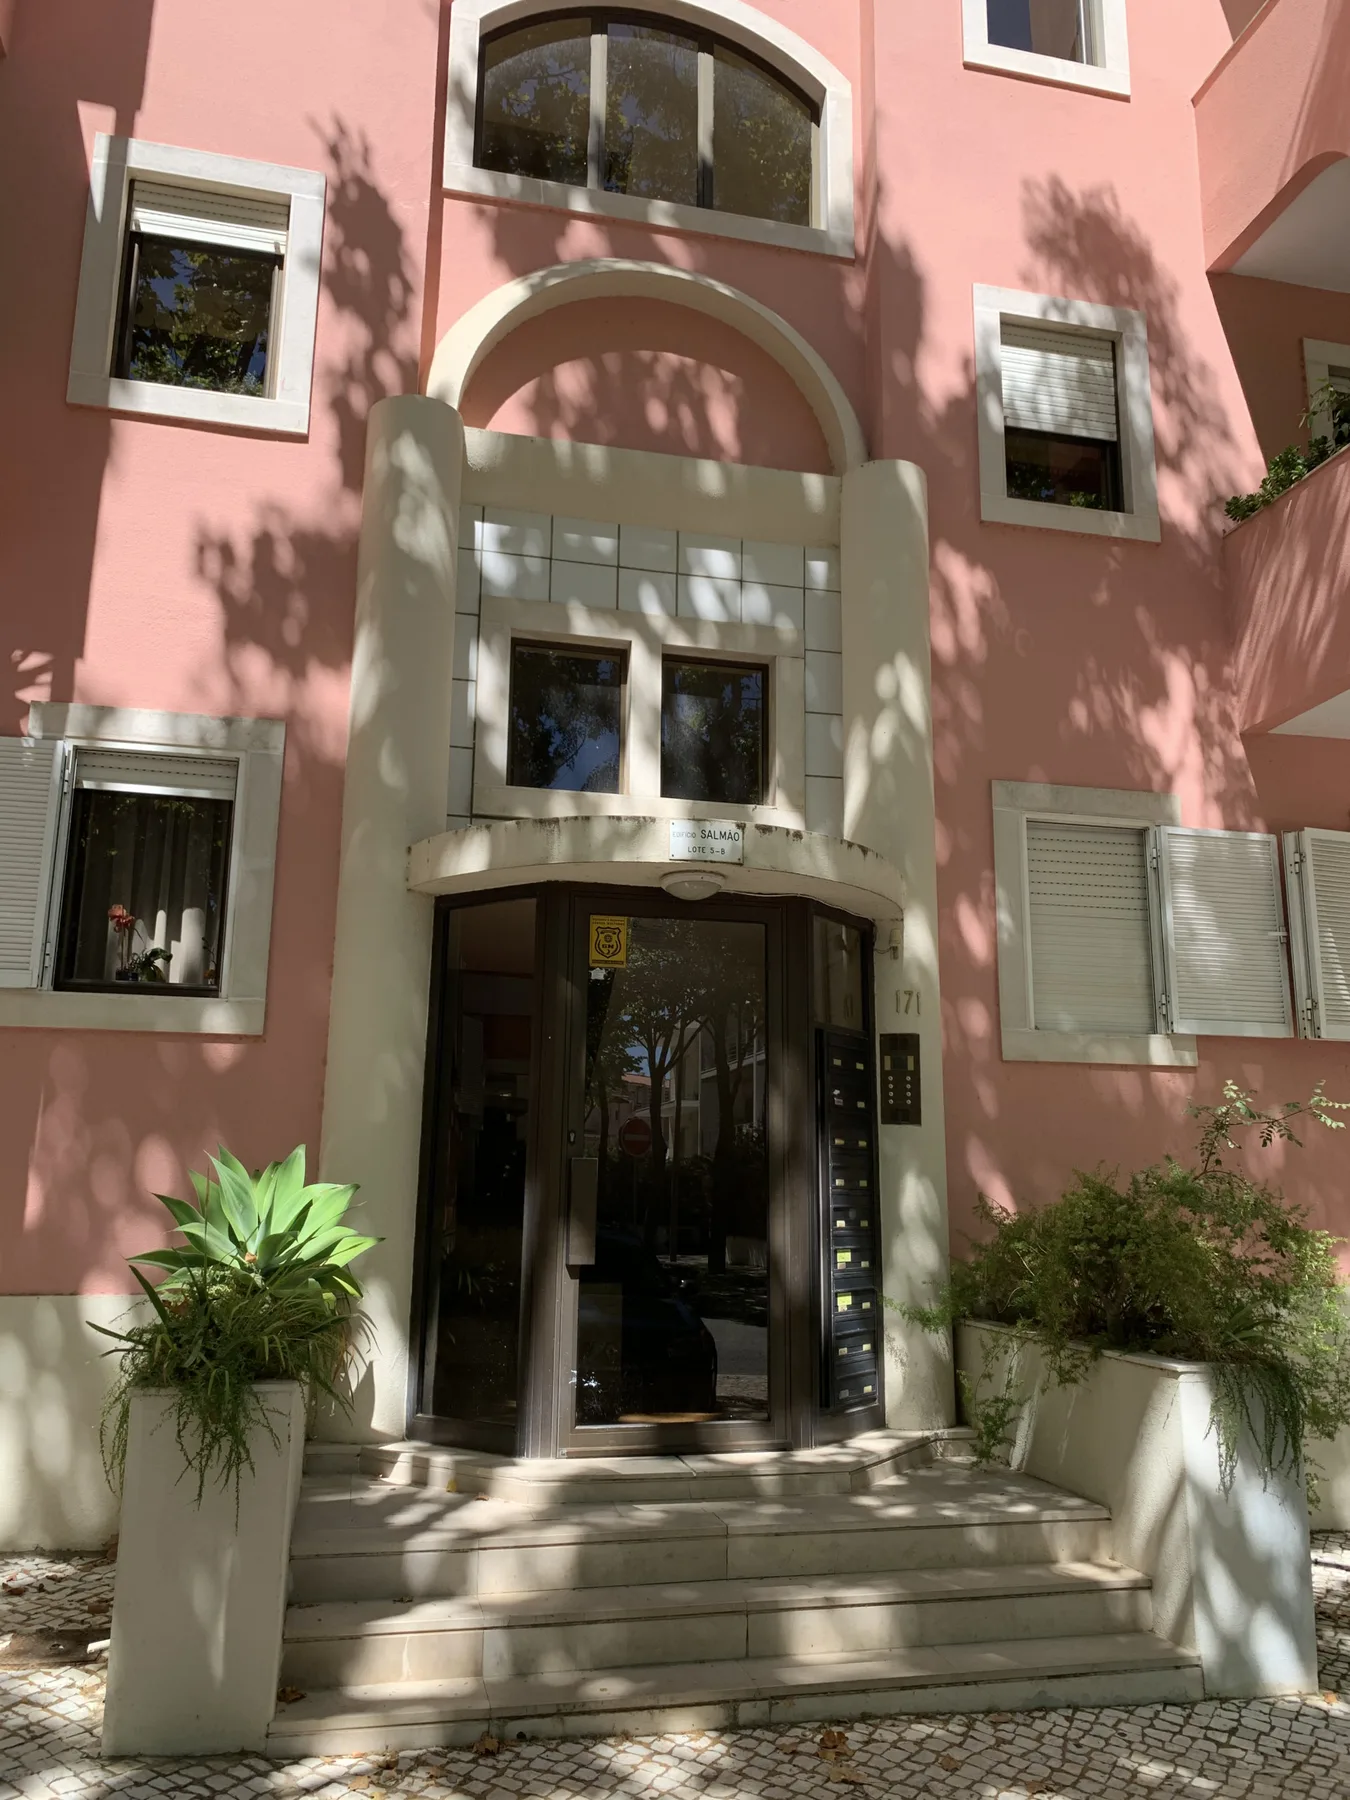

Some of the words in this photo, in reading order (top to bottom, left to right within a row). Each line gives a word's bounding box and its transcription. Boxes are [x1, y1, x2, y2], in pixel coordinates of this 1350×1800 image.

[700, 829, 740, 842] SALMÃO
[687, 846, 706, 854] LOTE
[895, 989, 921, 1015] 171
